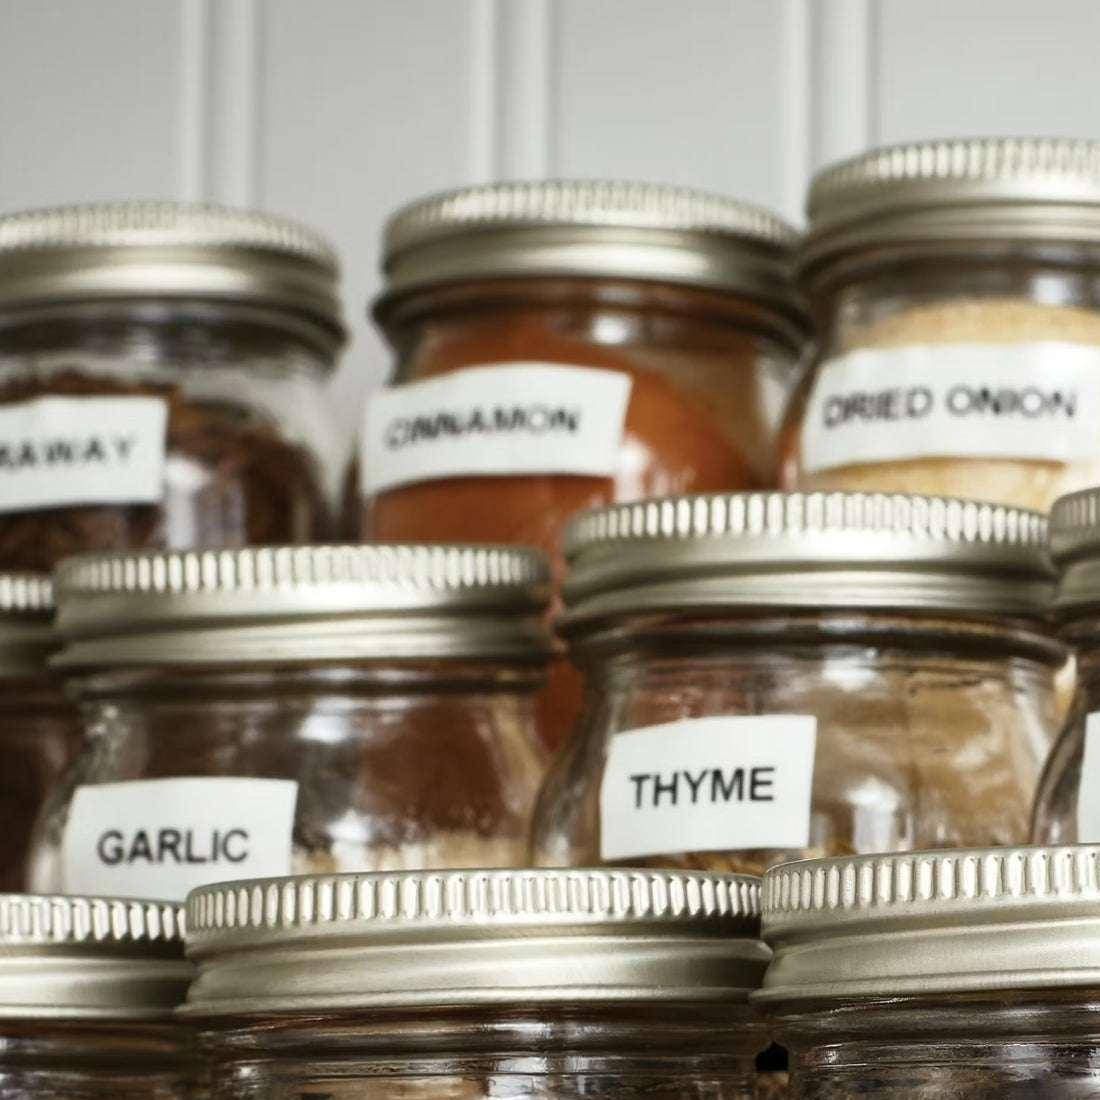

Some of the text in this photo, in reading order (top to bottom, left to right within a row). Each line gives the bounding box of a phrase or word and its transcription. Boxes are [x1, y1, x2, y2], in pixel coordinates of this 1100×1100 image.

[384, 403, 580, 451] CINNAMON
[822, 384, 1078, 428] DRIED ONION
[629, 765, 776, 809] THYME
[96, 827, 250, 866] GARLIC
